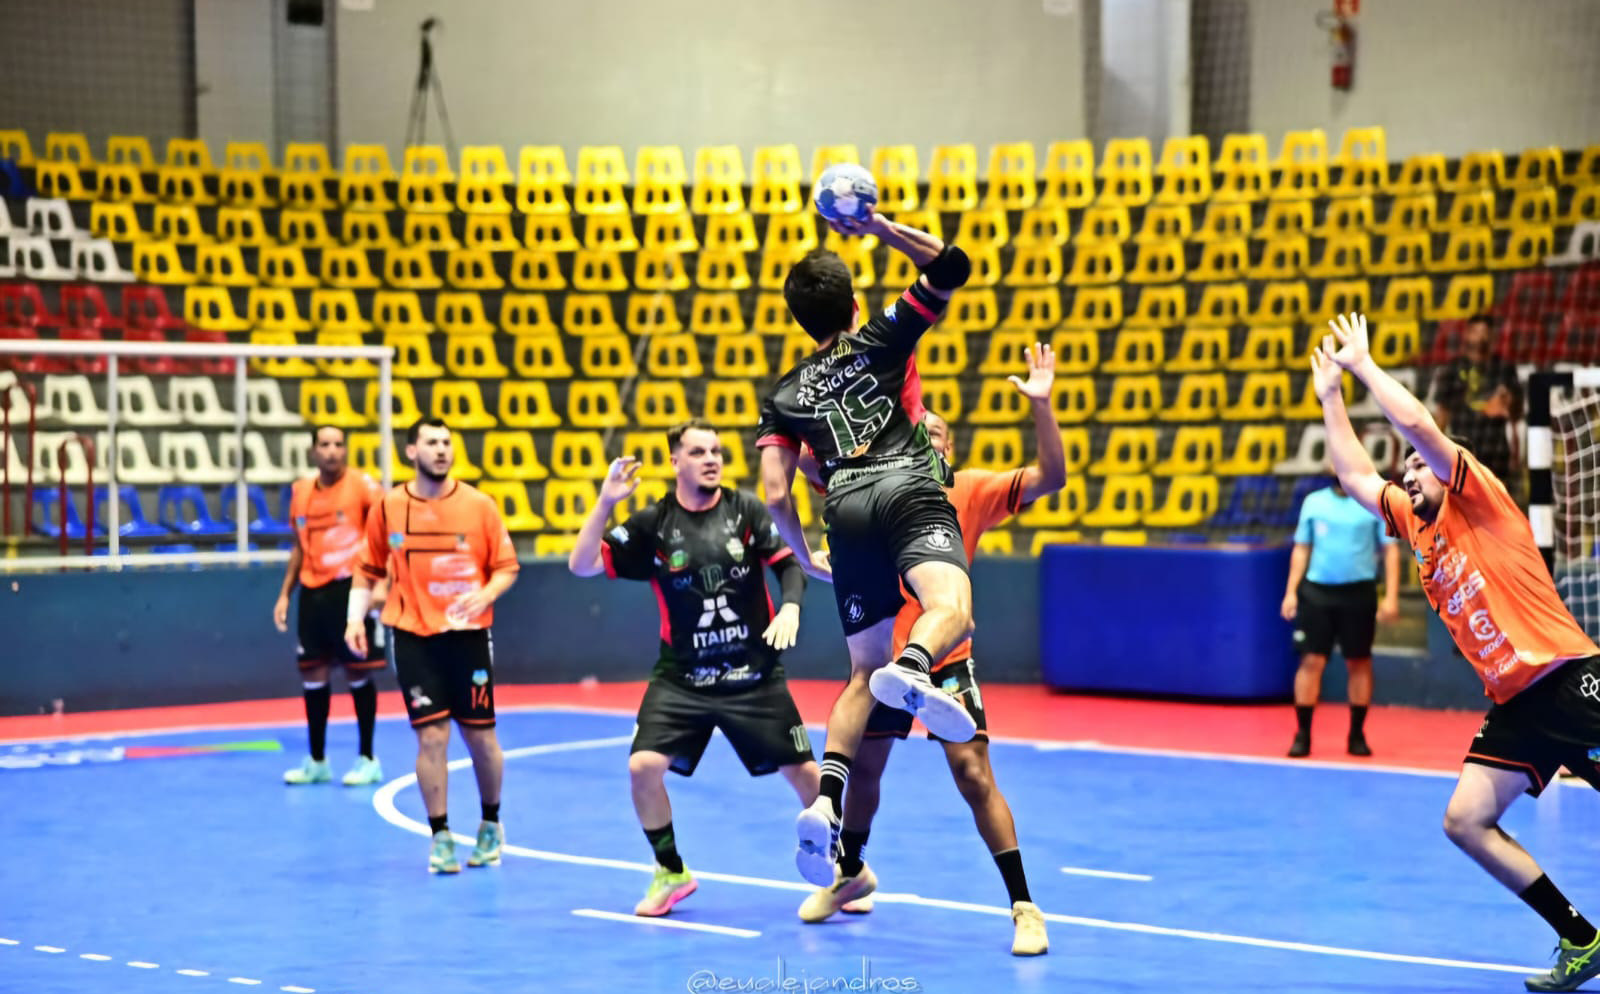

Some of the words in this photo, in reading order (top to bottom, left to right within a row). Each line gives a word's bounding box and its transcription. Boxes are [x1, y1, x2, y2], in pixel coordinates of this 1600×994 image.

[816, 354, 871, 397] Sicredi
[814, 373, 893, 458] 15
[693, 624, 748, 649] ITAIPU
[471, 686, 489, 709] 14
